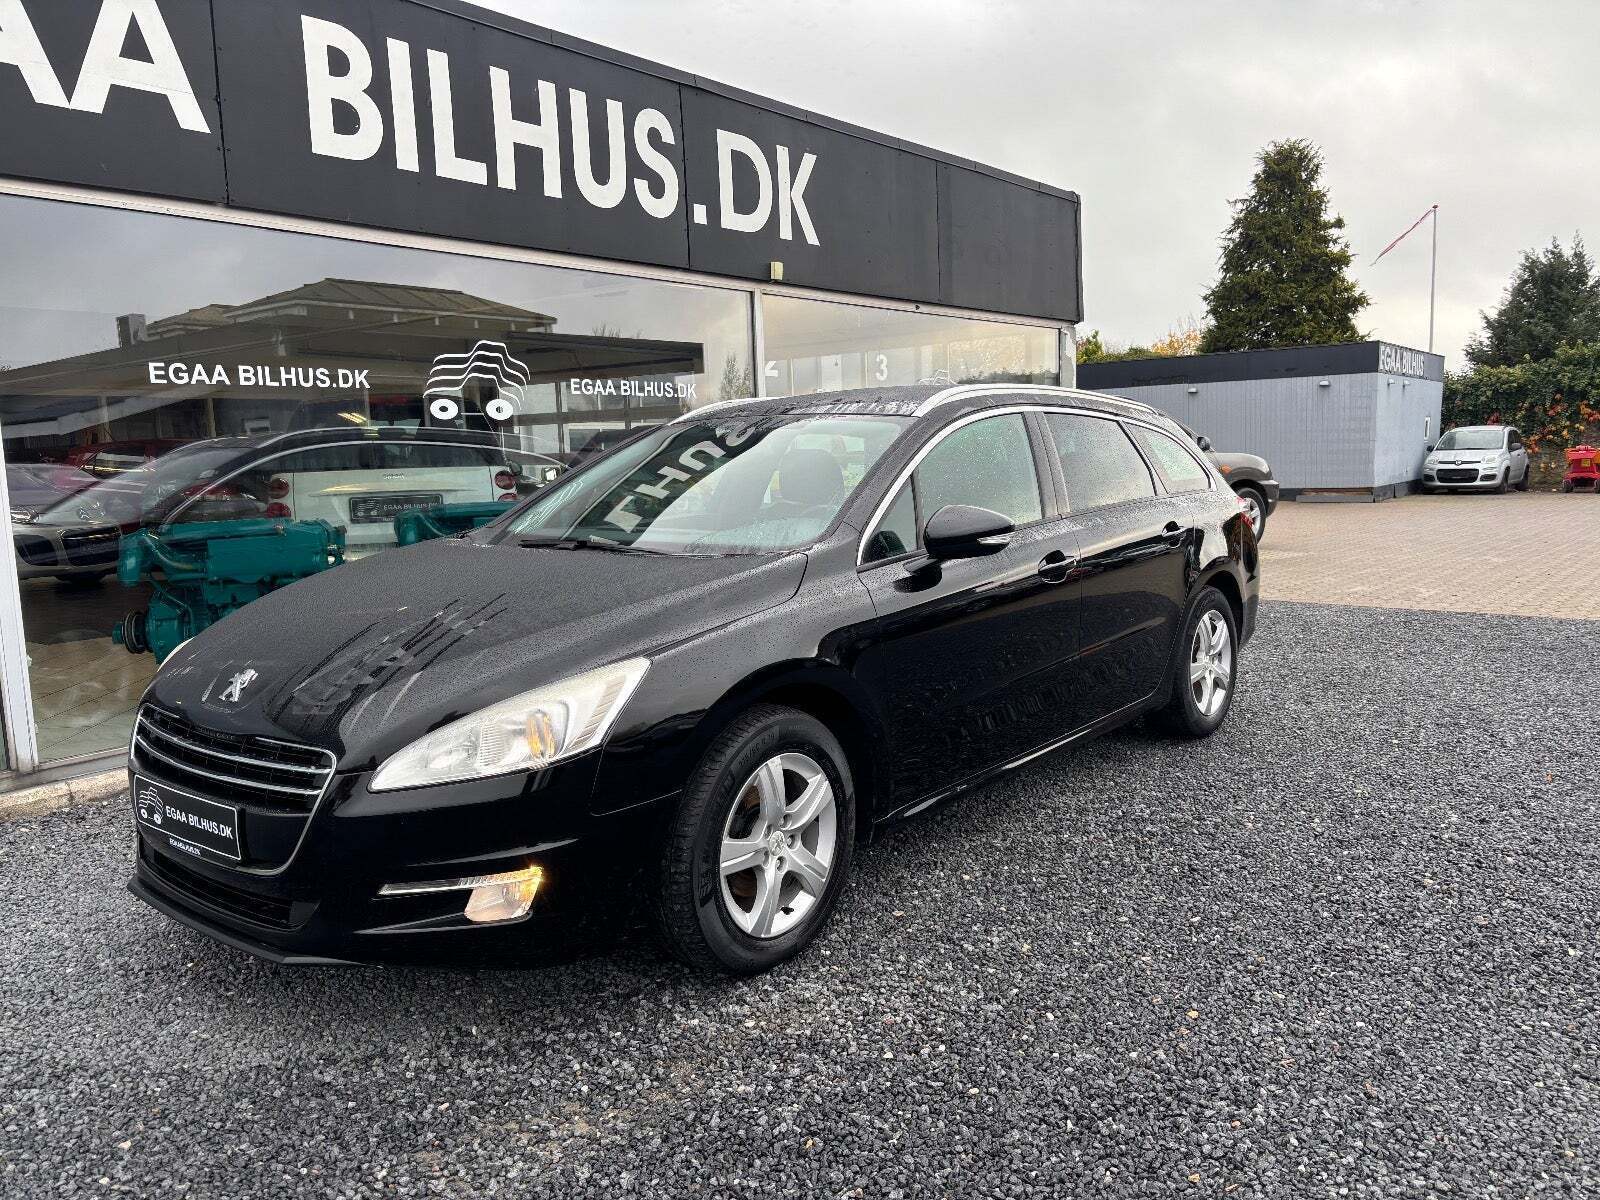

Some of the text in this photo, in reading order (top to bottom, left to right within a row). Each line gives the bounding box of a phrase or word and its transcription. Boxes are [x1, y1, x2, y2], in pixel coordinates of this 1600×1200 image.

[301, 14, 821, 247] BILHUS.DK
[148, 362, 371, 389] EGAA BILHUS.DK
[875, 354, 888, 381] 3
[1380, 345, 1424, 377] EGAA BILHUS
[570, 378, 698, 400] EGAA BILHUS.DK
[165, 805, 234, 840] EGAA BILHUS.DK
